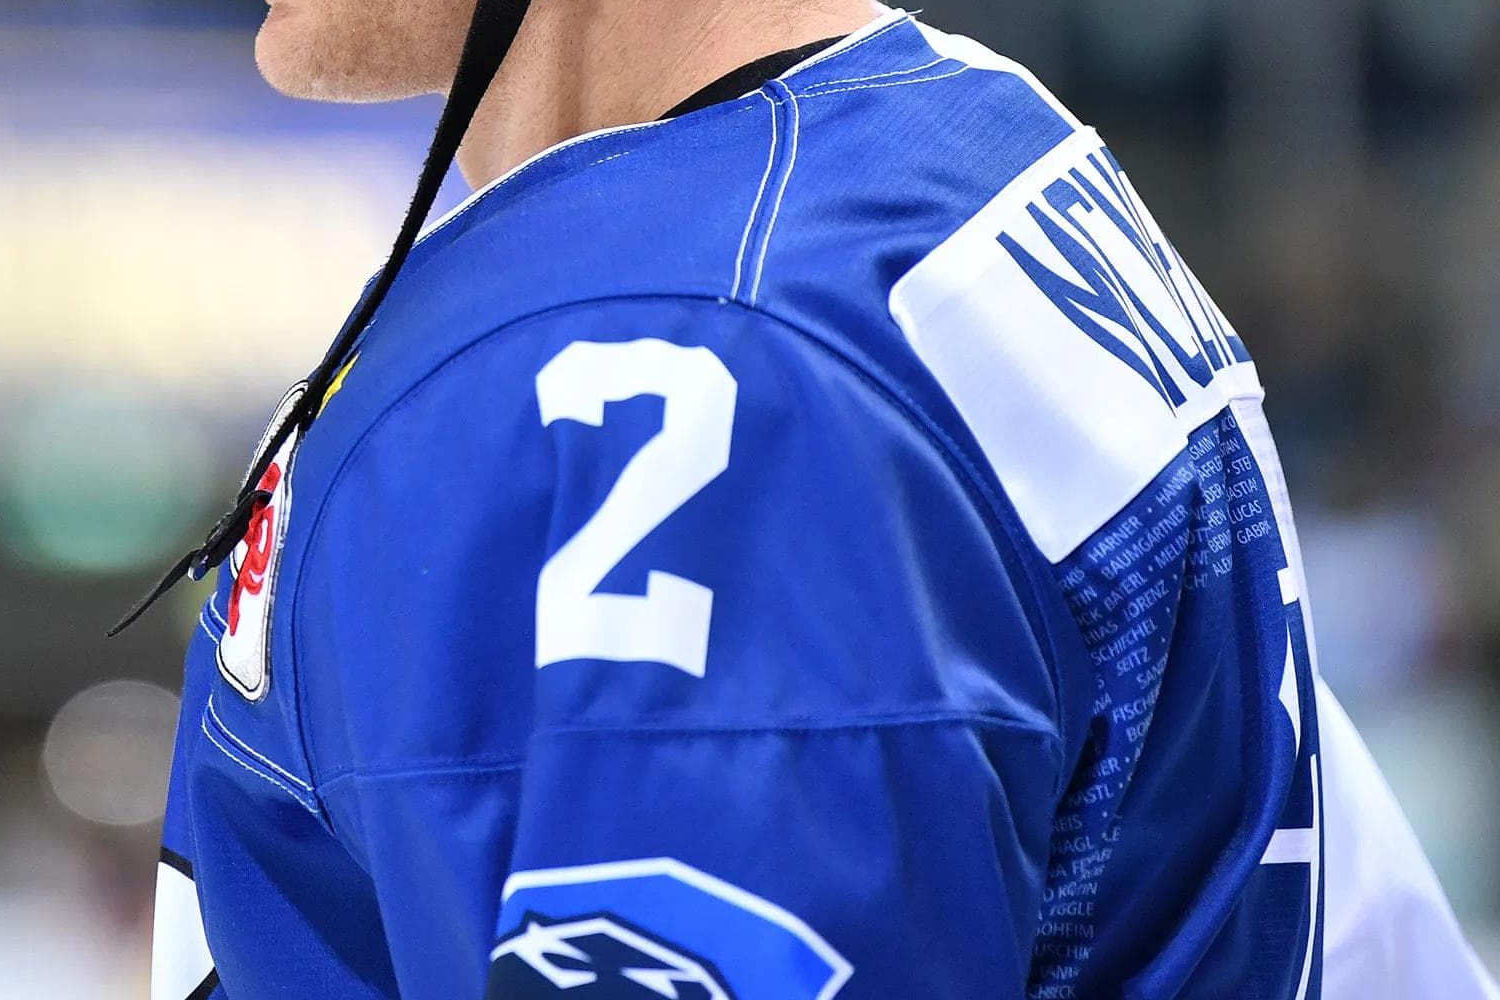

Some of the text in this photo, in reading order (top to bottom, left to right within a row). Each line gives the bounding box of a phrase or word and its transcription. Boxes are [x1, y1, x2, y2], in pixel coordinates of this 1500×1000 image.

[1188, 436, 1216, 461] SMIN
[536, 337, 738, 678] 2
[1227, 500, 1263, 525] LUCAS
[1088, 515, 1144, 563] HARNER
[1101, 504, 1189, 580] BAUMGARTNER
[1116, 646, 1151, 677] SEITZ
